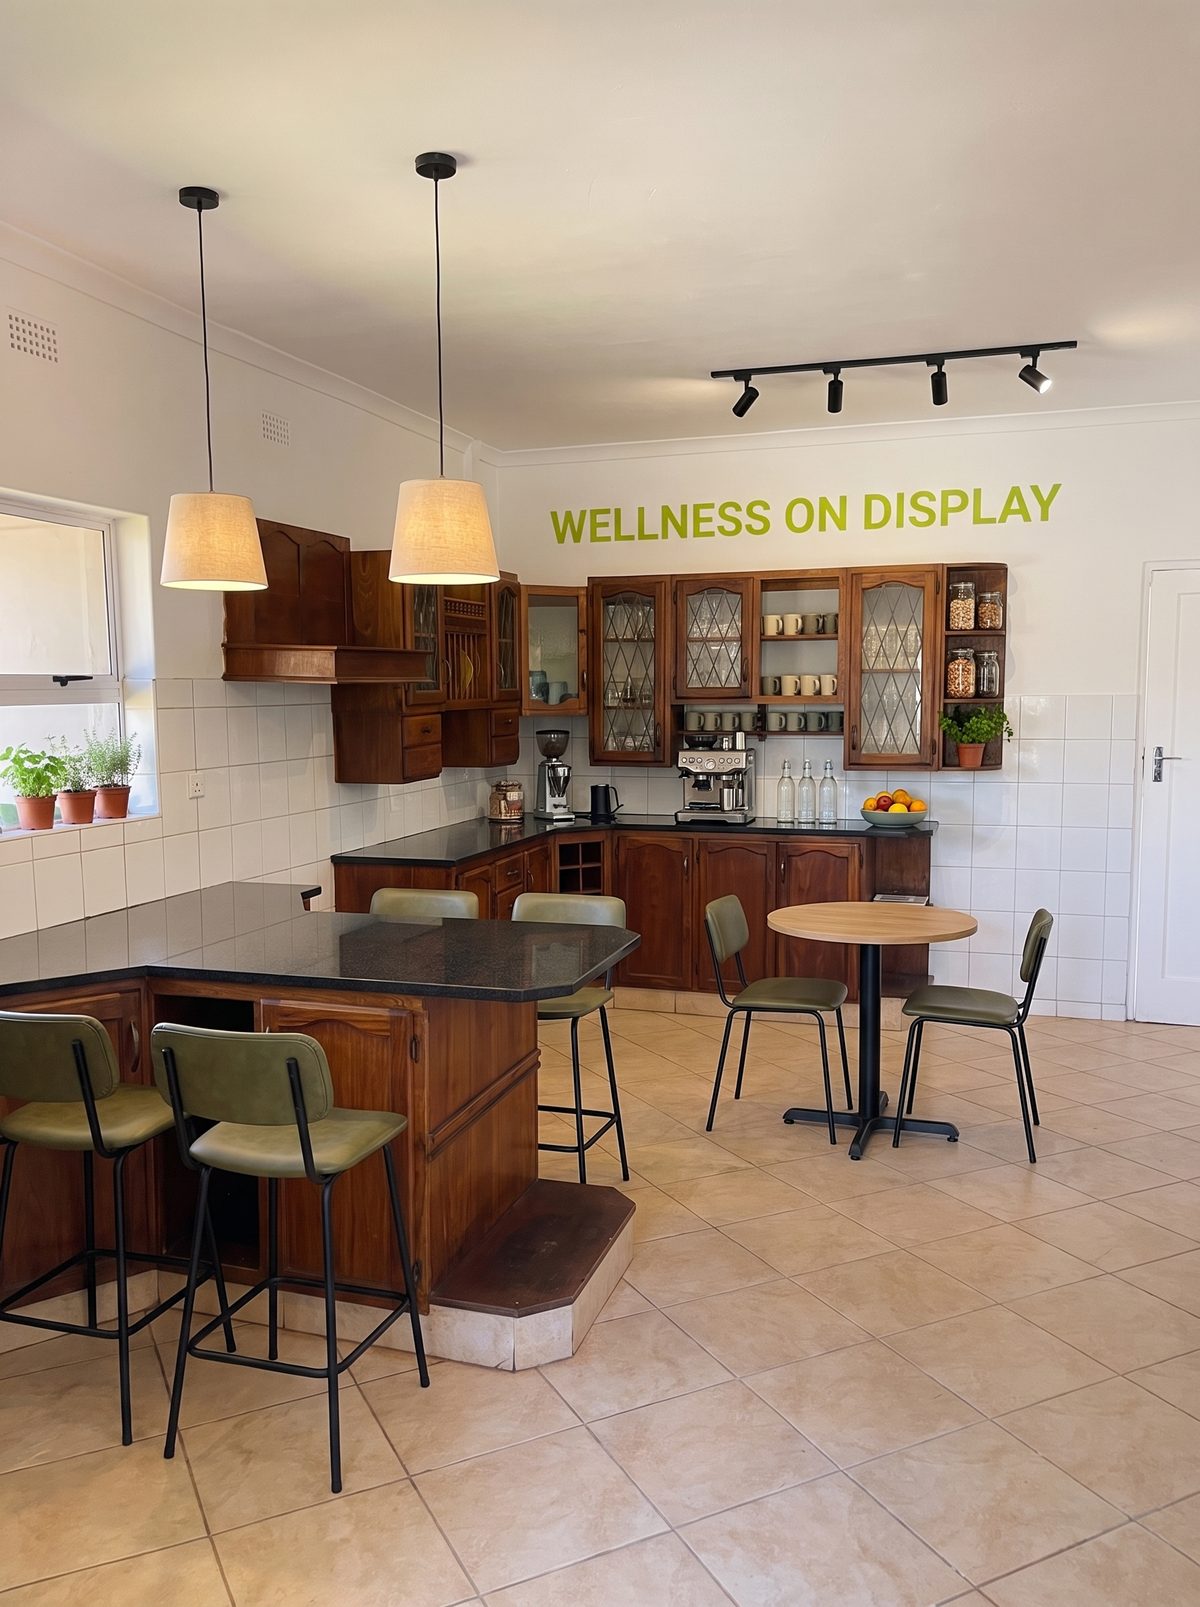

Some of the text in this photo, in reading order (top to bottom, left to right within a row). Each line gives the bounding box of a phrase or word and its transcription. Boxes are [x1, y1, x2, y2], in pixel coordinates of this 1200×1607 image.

[550, 483, 1062, 544] WELLNESS ON DISPLAY
